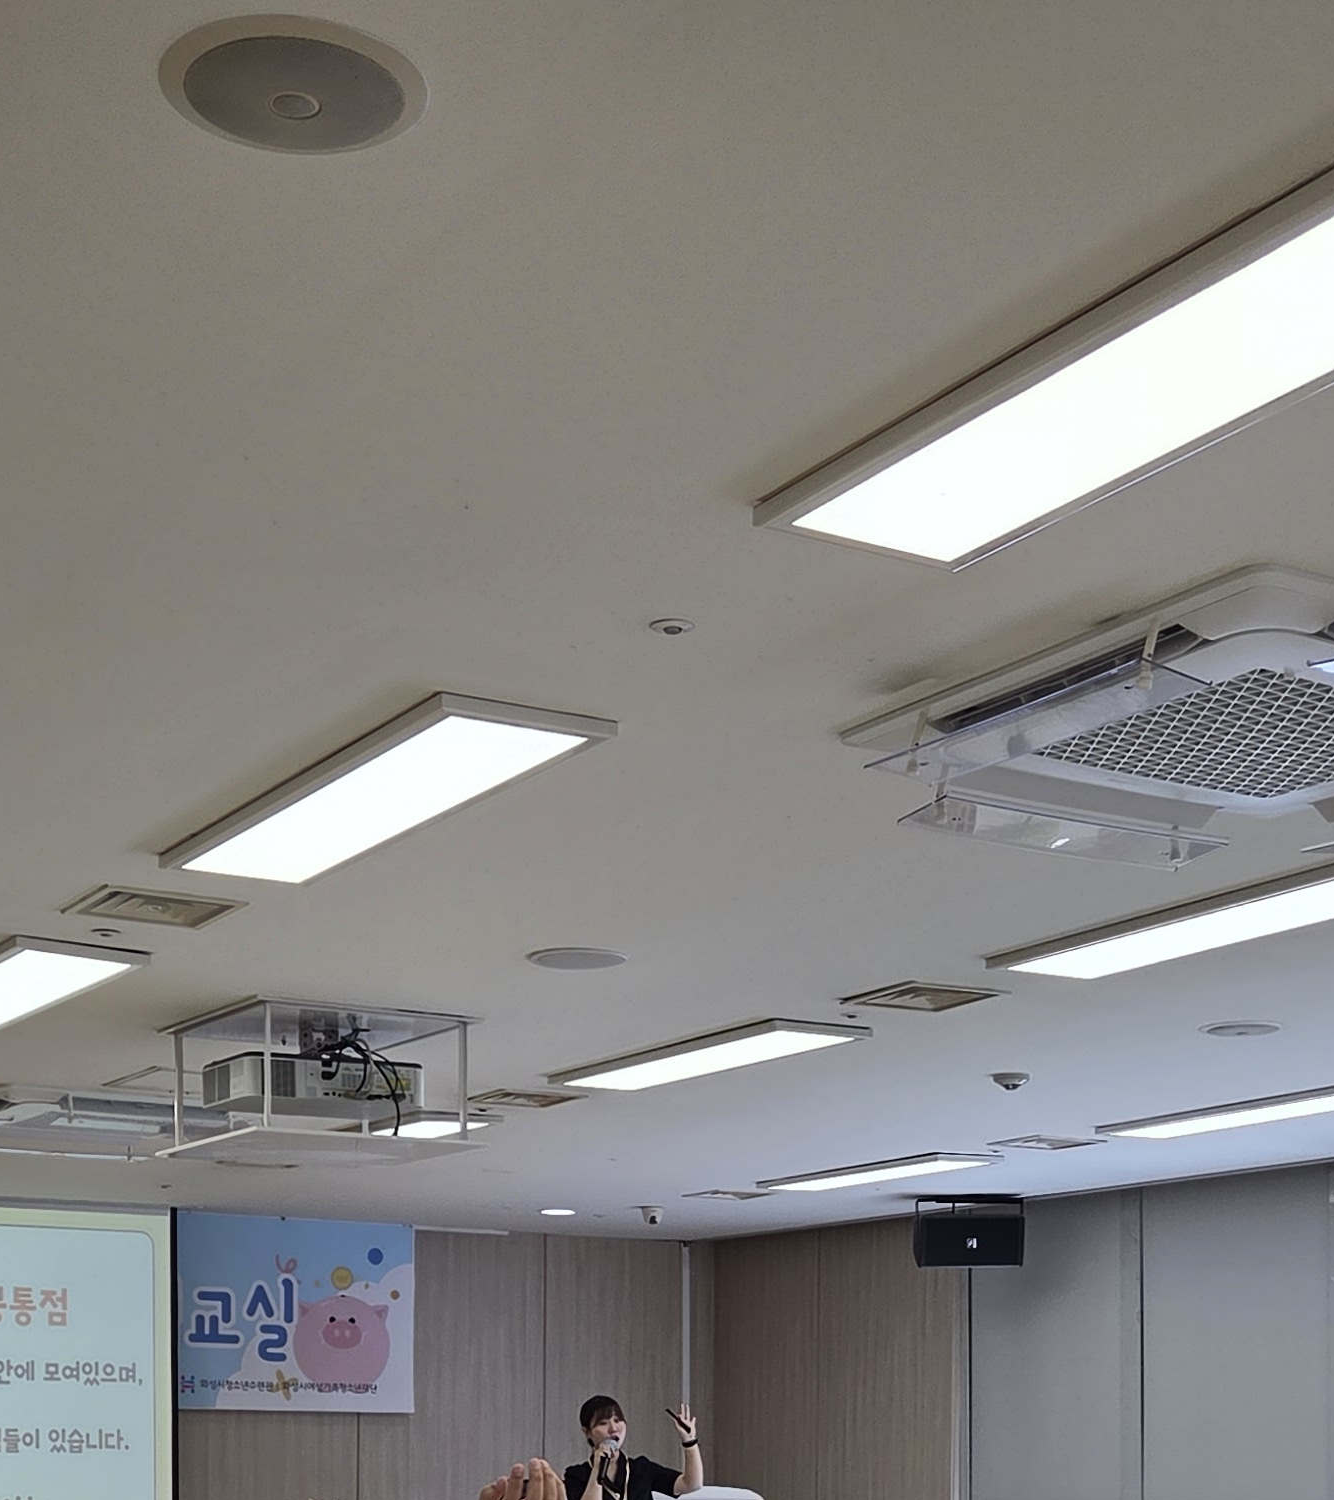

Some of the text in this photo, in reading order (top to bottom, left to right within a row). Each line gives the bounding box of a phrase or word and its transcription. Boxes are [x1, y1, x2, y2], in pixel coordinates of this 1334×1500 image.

[187, 1277, 295, 1362] 교실
[42, 1360, 144, 1387] 모여있으며,
[47, 1427, 131, 1455] 있습니다.
